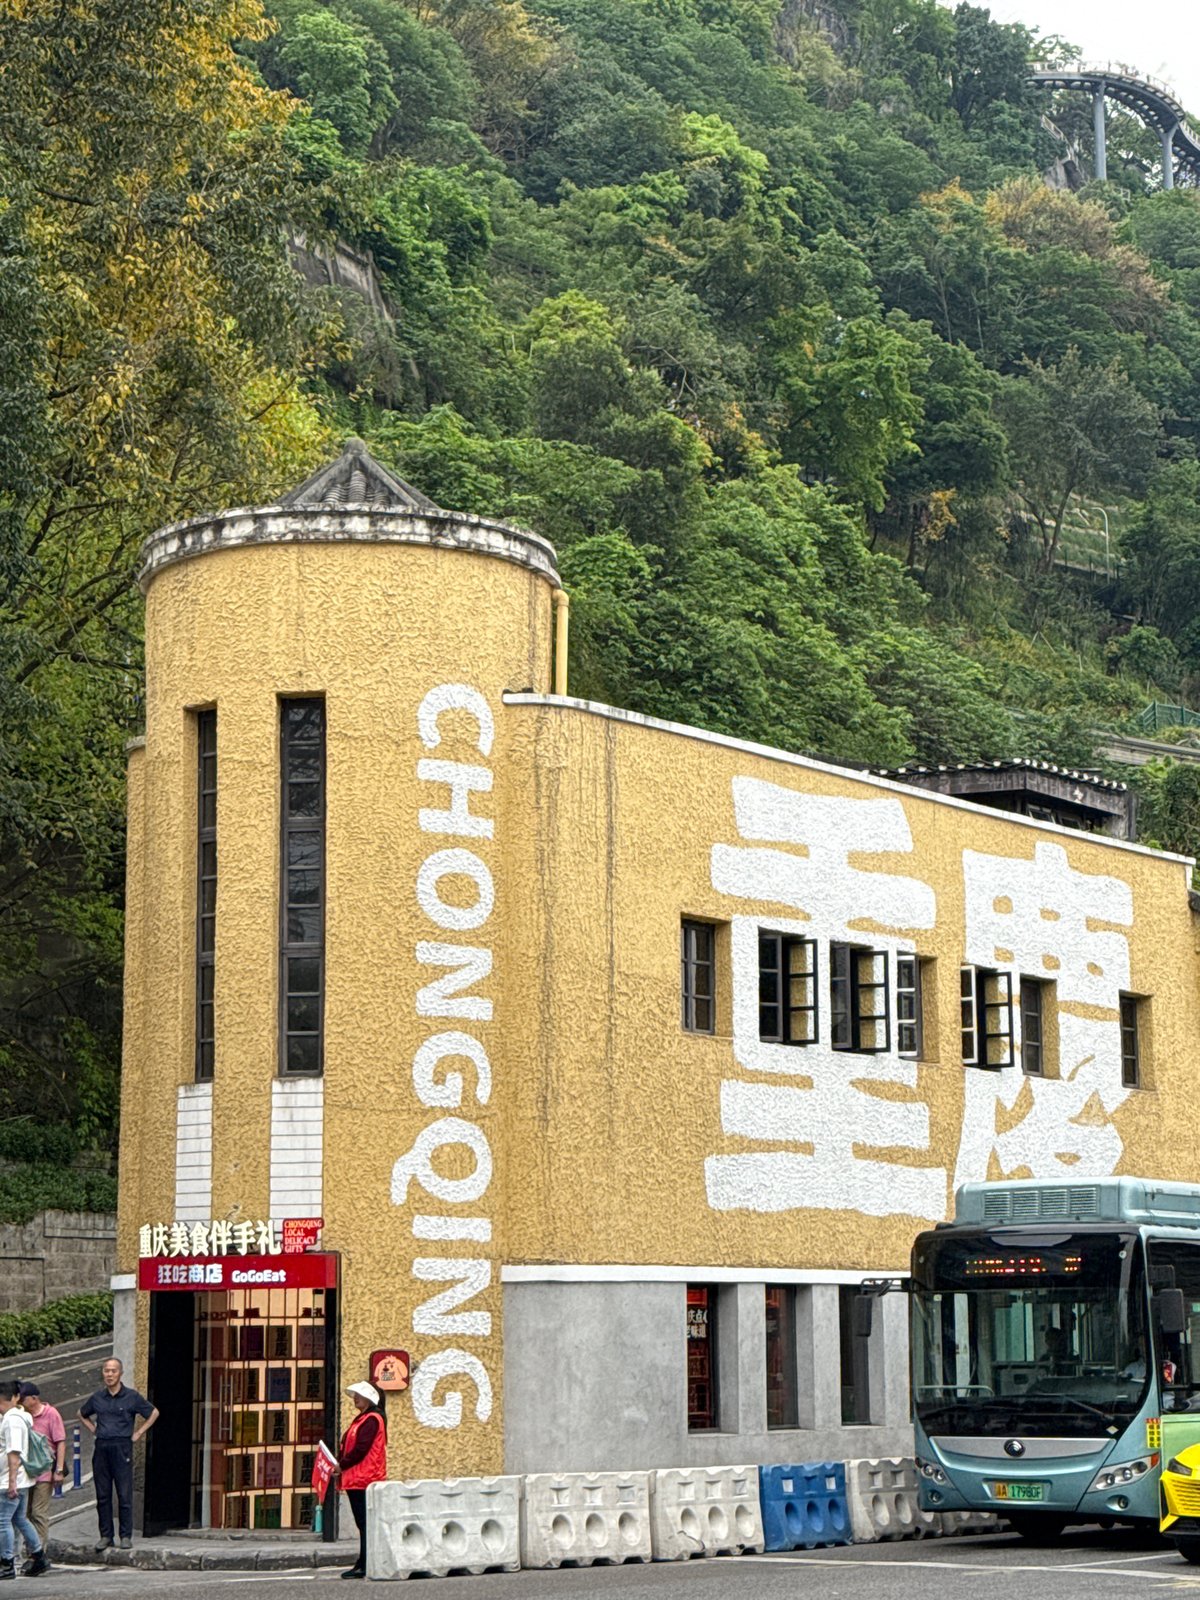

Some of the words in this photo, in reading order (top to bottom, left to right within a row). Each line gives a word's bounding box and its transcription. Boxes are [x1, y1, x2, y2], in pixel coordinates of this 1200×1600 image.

[390, 683, 494, 1429] CHONGQING
[284, 1220, 322, 1228] CHONGQING
[284, 1228, 305, 1236] LOCAL
[139, 1219, 282, 1257] 重庆美食伴手礼
[284, 1236, 315, 1245] DELICACY
[284, 1244, 304, 1253] GIFTS
[158, 1263, 223, 1284] 狂吃商店
[231, 1269, 287, 1283] GoGoEat
